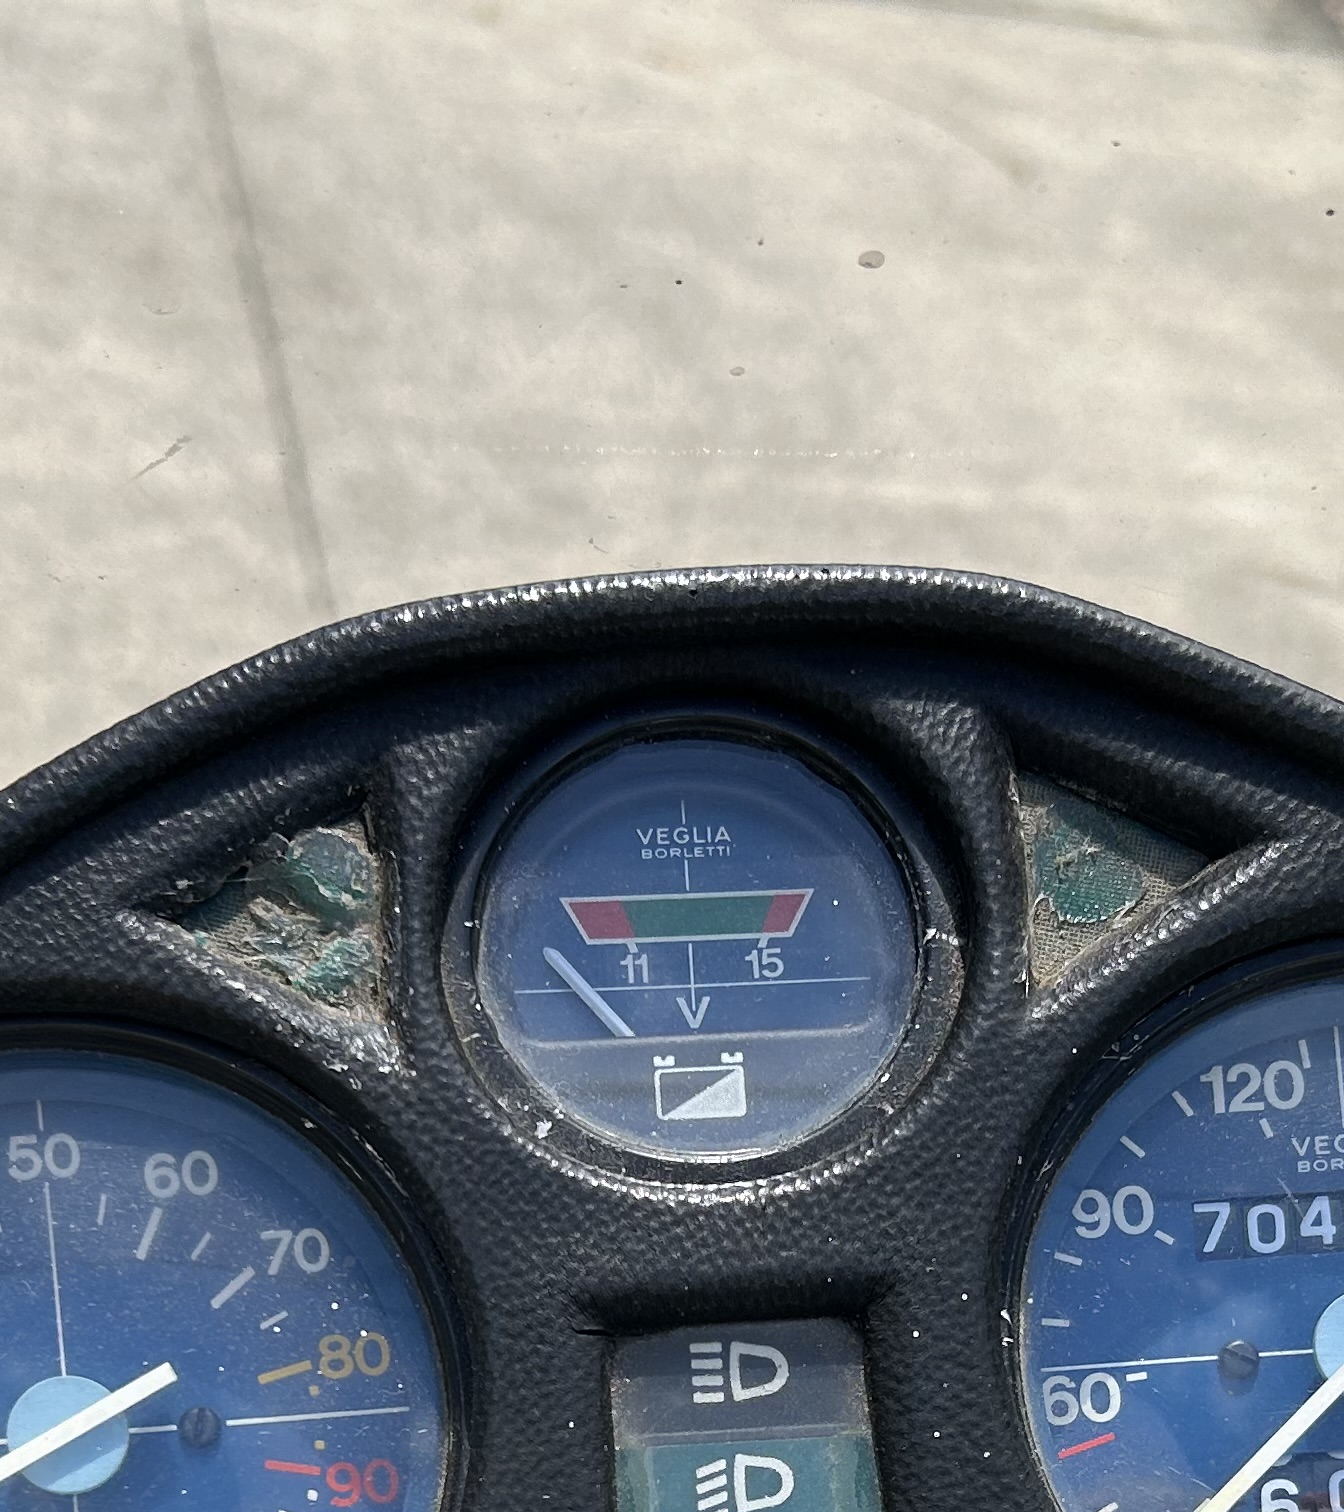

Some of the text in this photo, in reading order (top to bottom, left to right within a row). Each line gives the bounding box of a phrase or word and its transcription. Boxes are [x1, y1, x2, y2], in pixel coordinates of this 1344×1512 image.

[636, 826, 732, 845] VEGLIA
[641, 846, 732, 859] BORLETTI
[620, 954, 649, 984] 11
[745, 949, 784, 979] 15
[676, 997, 710, 1029] V
[1200, 1059, 1305, 1115] 120
[7, 1132, 82, 1181] 50
[143, 1149, 219, 1197] 60
[1072, 1185, 1154, 1240] 90
[259, 1227, 331, 1275] 70
[318, 1331, 391, 1379] 80
[1041, 1372, 1122, 1426] 60
[325, 1458, 399, 1508] 90
